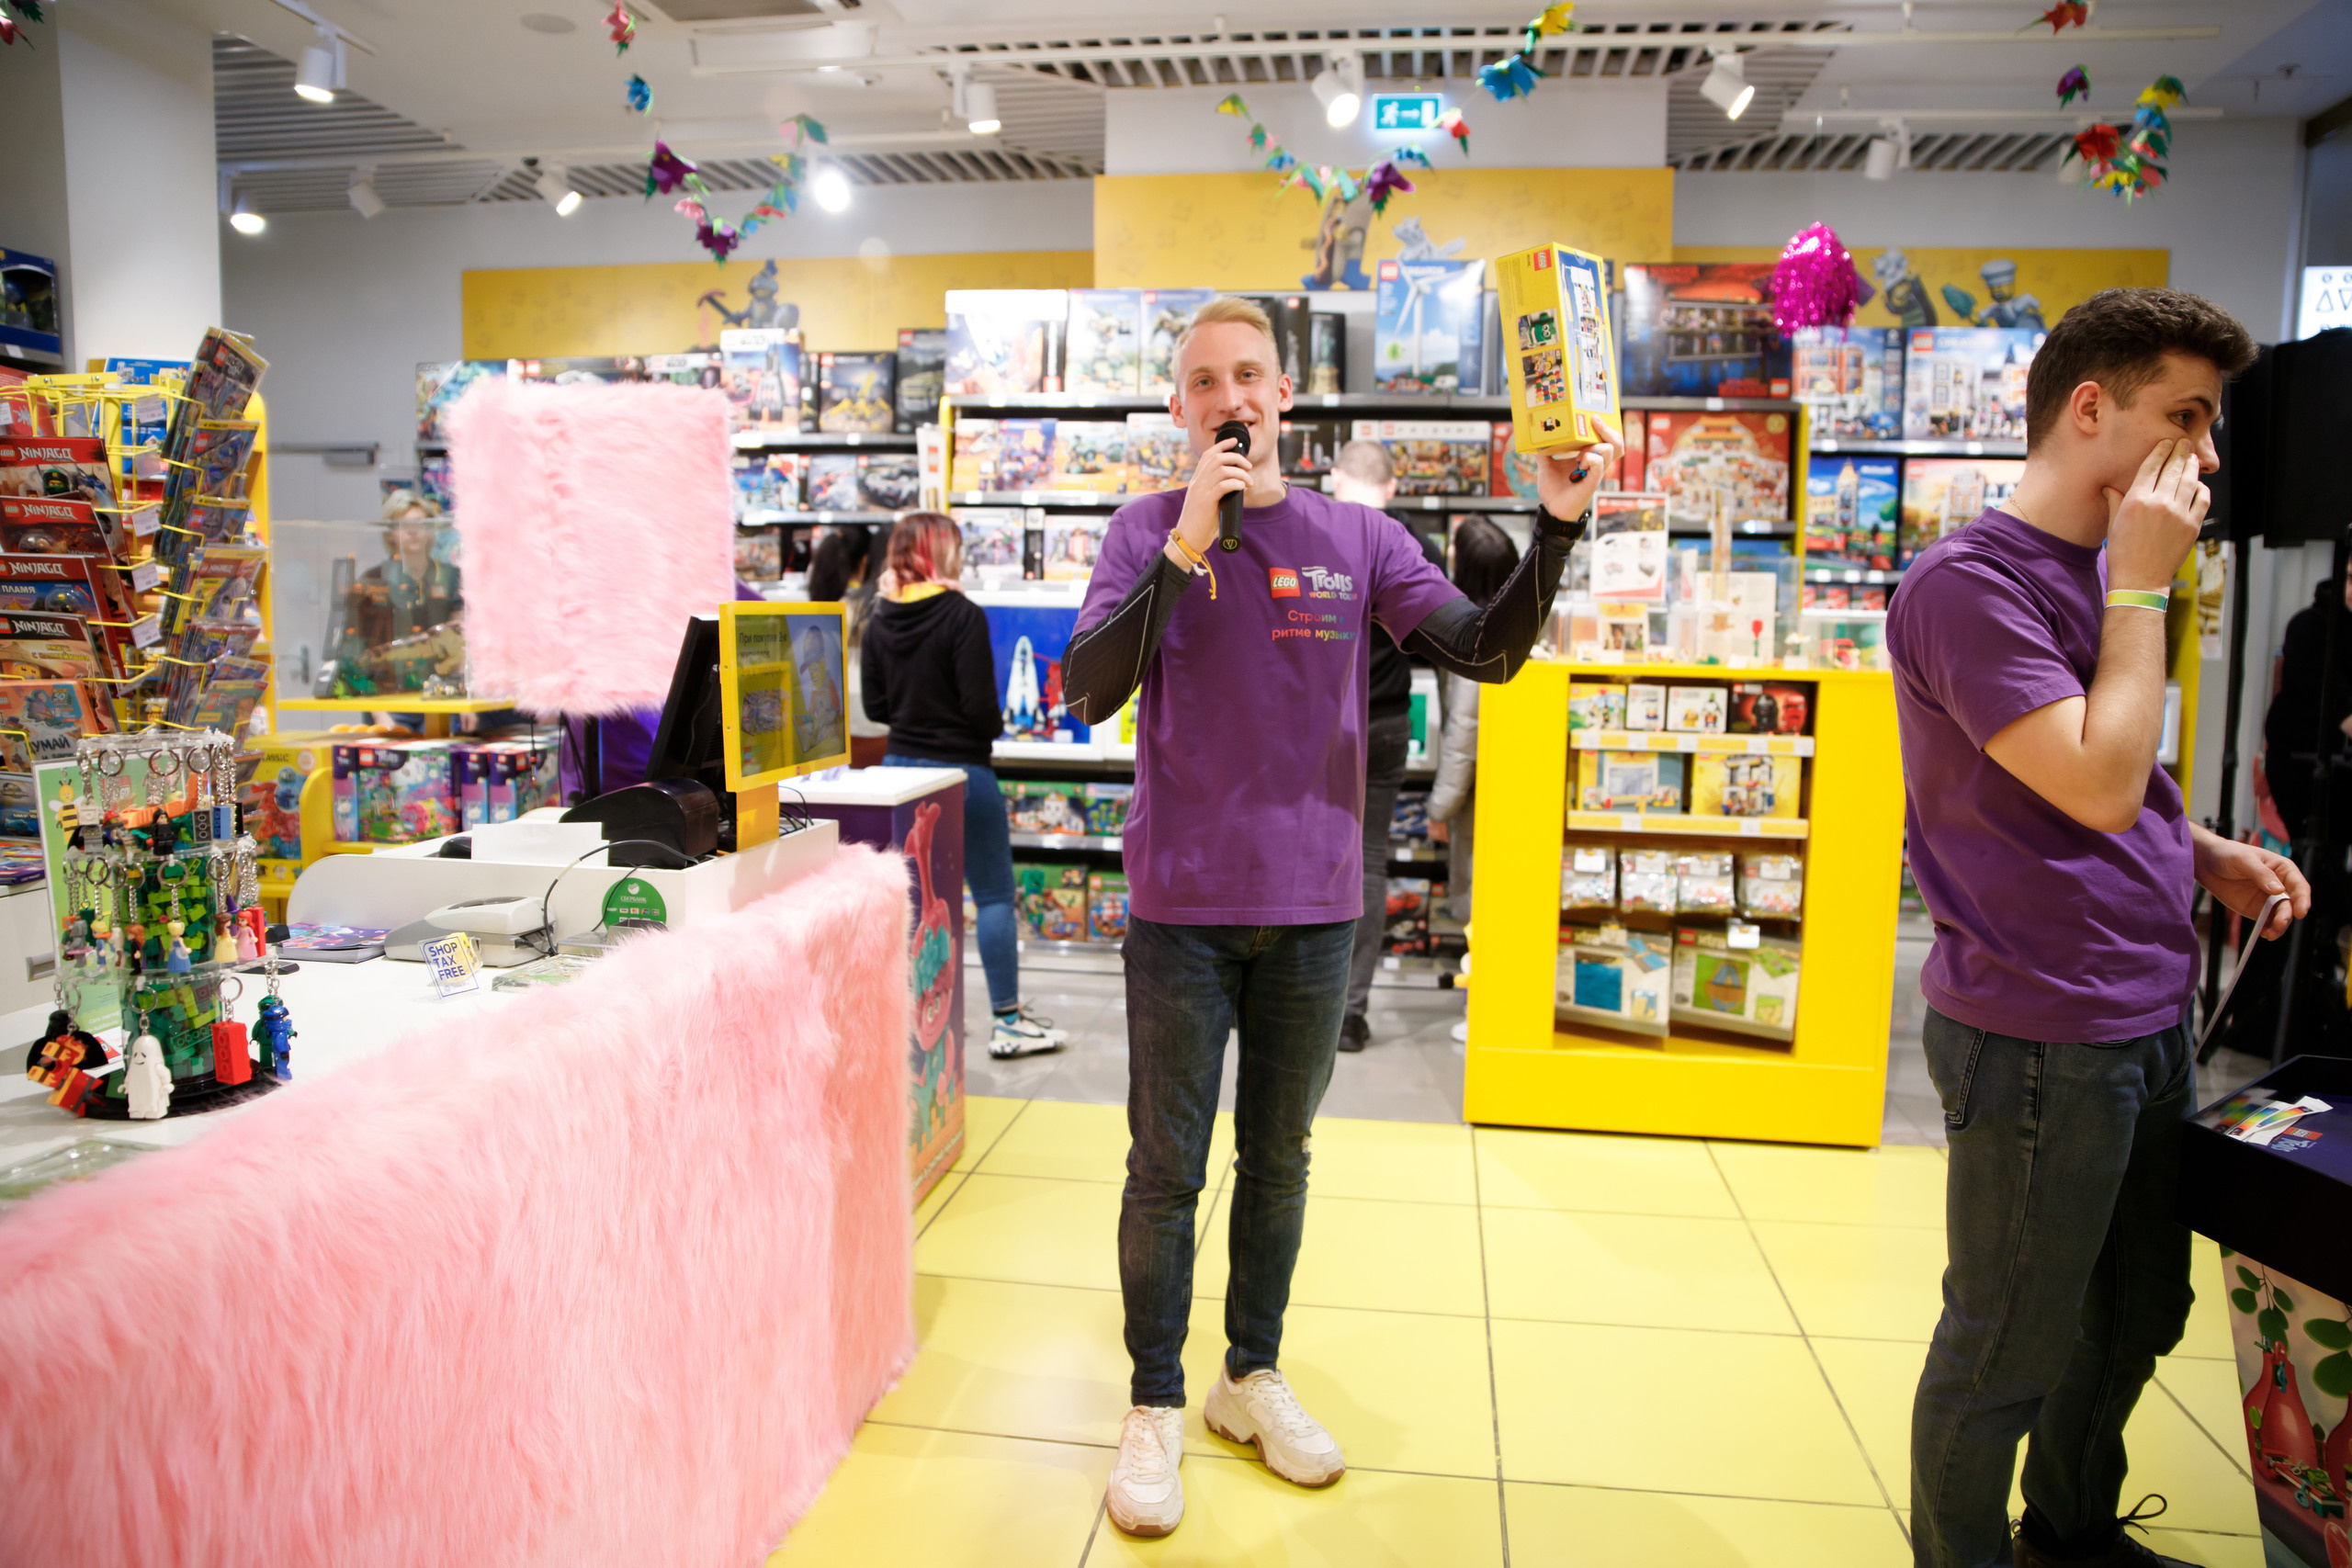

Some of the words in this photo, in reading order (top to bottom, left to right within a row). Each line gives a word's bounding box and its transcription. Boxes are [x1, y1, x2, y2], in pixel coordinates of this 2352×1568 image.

[17, 446, 77, 462] NINJAGO
[22, 504, 79, 520] NINJAGO
[8, 562, 68, 577] NINJAGO
[1272, 576, 1297, 588] LEGO
[1301, 570, 1353, 592] Trolls
[1, 585, 36, 594] ПЛАМЯ
[1308, 591, 1337, 599] WORLD
[1287, 610, 1337, 624] Строим
[12, 620, 71, 637] NINJAGO
[1272, 628, 1311, 641] ритме
[1315, 629, 1356, 641] музыки
[53, 693, 66, 702] 50
[428, 942, 458, 957] SHOP
[433, 955, 457, 969] TAX
[438, 965, 466, 981] FREE
